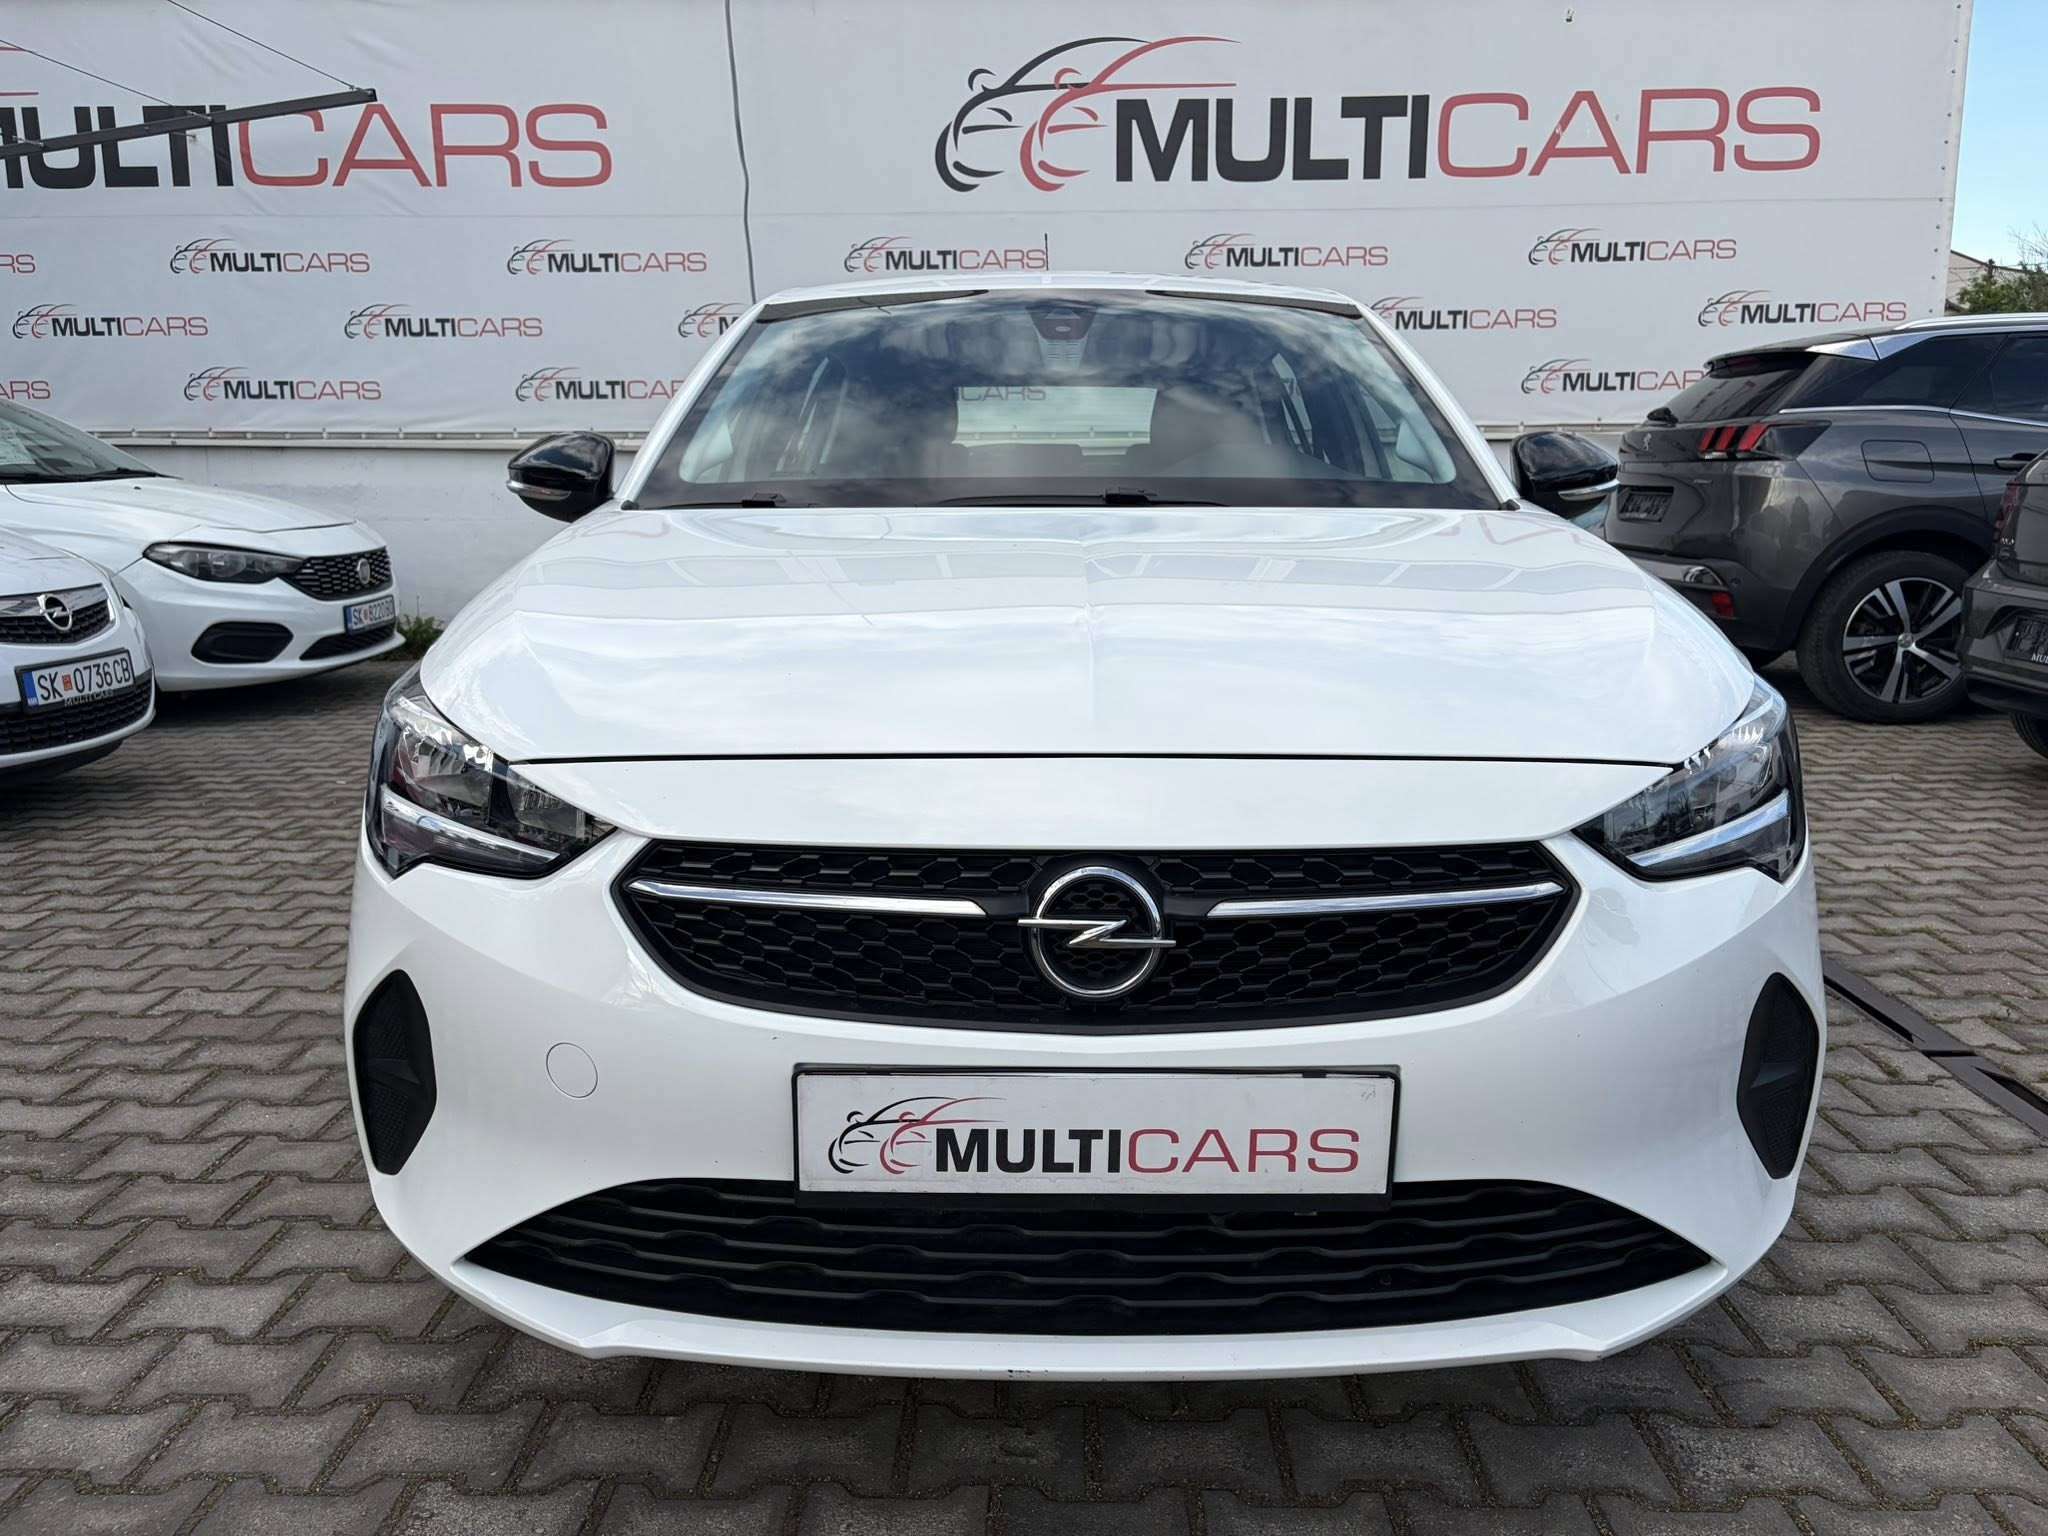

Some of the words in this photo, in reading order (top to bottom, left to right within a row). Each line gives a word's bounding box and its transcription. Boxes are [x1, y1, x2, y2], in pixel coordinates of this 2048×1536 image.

[0, 104, 612, 188] ULTICARS
[1115, 86, 1822, 184] MULTICARS
[885, 248, 1046, 271] MULTICARS
[1224, 245, 1388, 267] MULTICARS
[1570, 238, 1737, 263] MULTICARS
[210, 252, 370, 273] MULTICARS
[547, 252, 707, 273] MULTICARS
[1394, 308, 1557, 331] MULTICARS
[1740, 301, 1907, 325] MULTICARS
[52, 316, 208, 337] MULTICARS
[384, 316, 543, 338] MULTICARS
[223, 379, 381, 401] MULTICARS
[37, 671, 63, 701] SK
[935, 1128, 1360, 1175] MULTICARS
